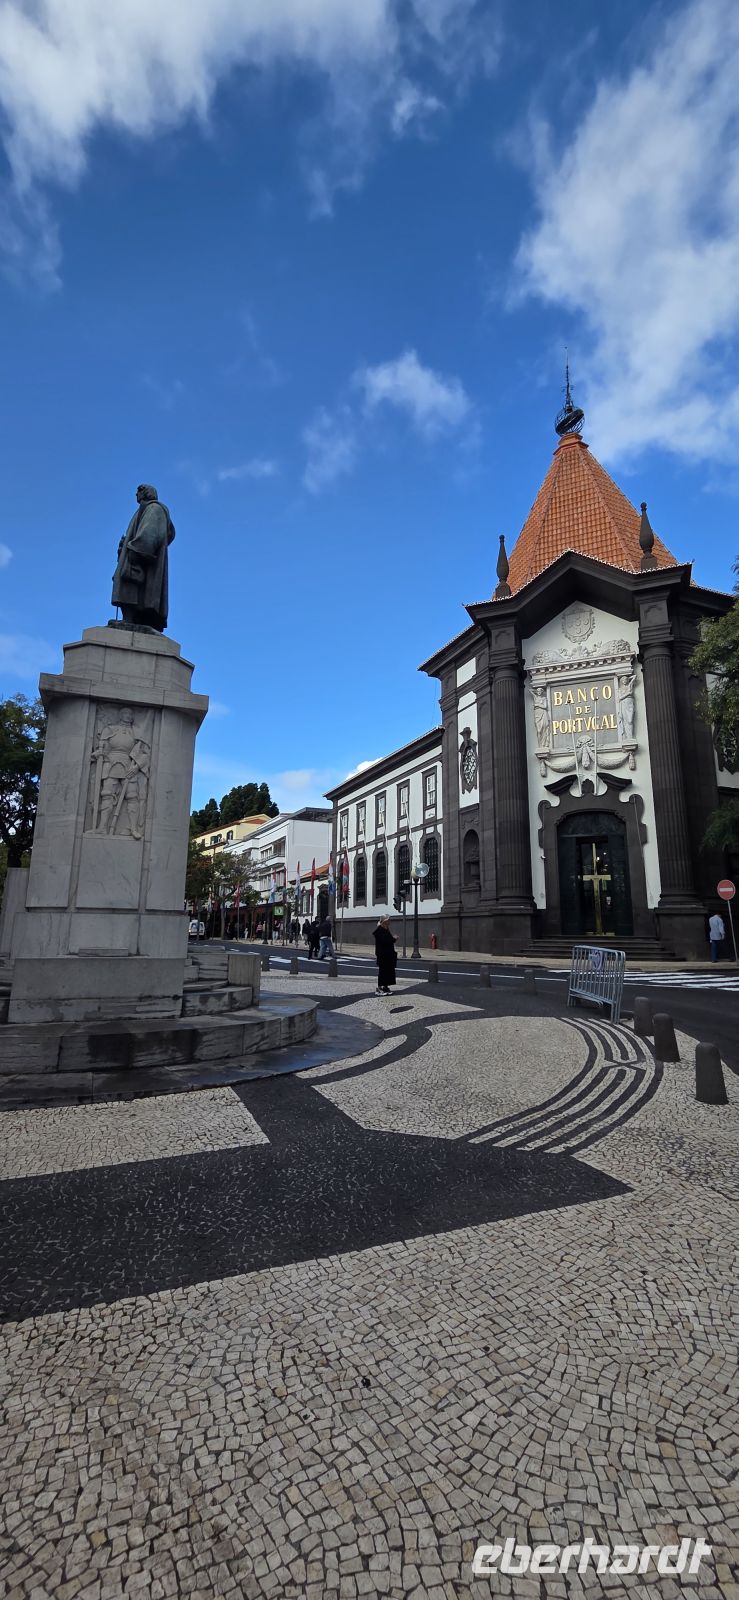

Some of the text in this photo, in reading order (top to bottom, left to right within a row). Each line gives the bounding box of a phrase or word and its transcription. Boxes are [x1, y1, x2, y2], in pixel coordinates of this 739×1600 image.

[554, 685, 612, 706] BANCO
[575, 705, 592, 715] DE
[552, 714, 618, 735] PORTVGAL
